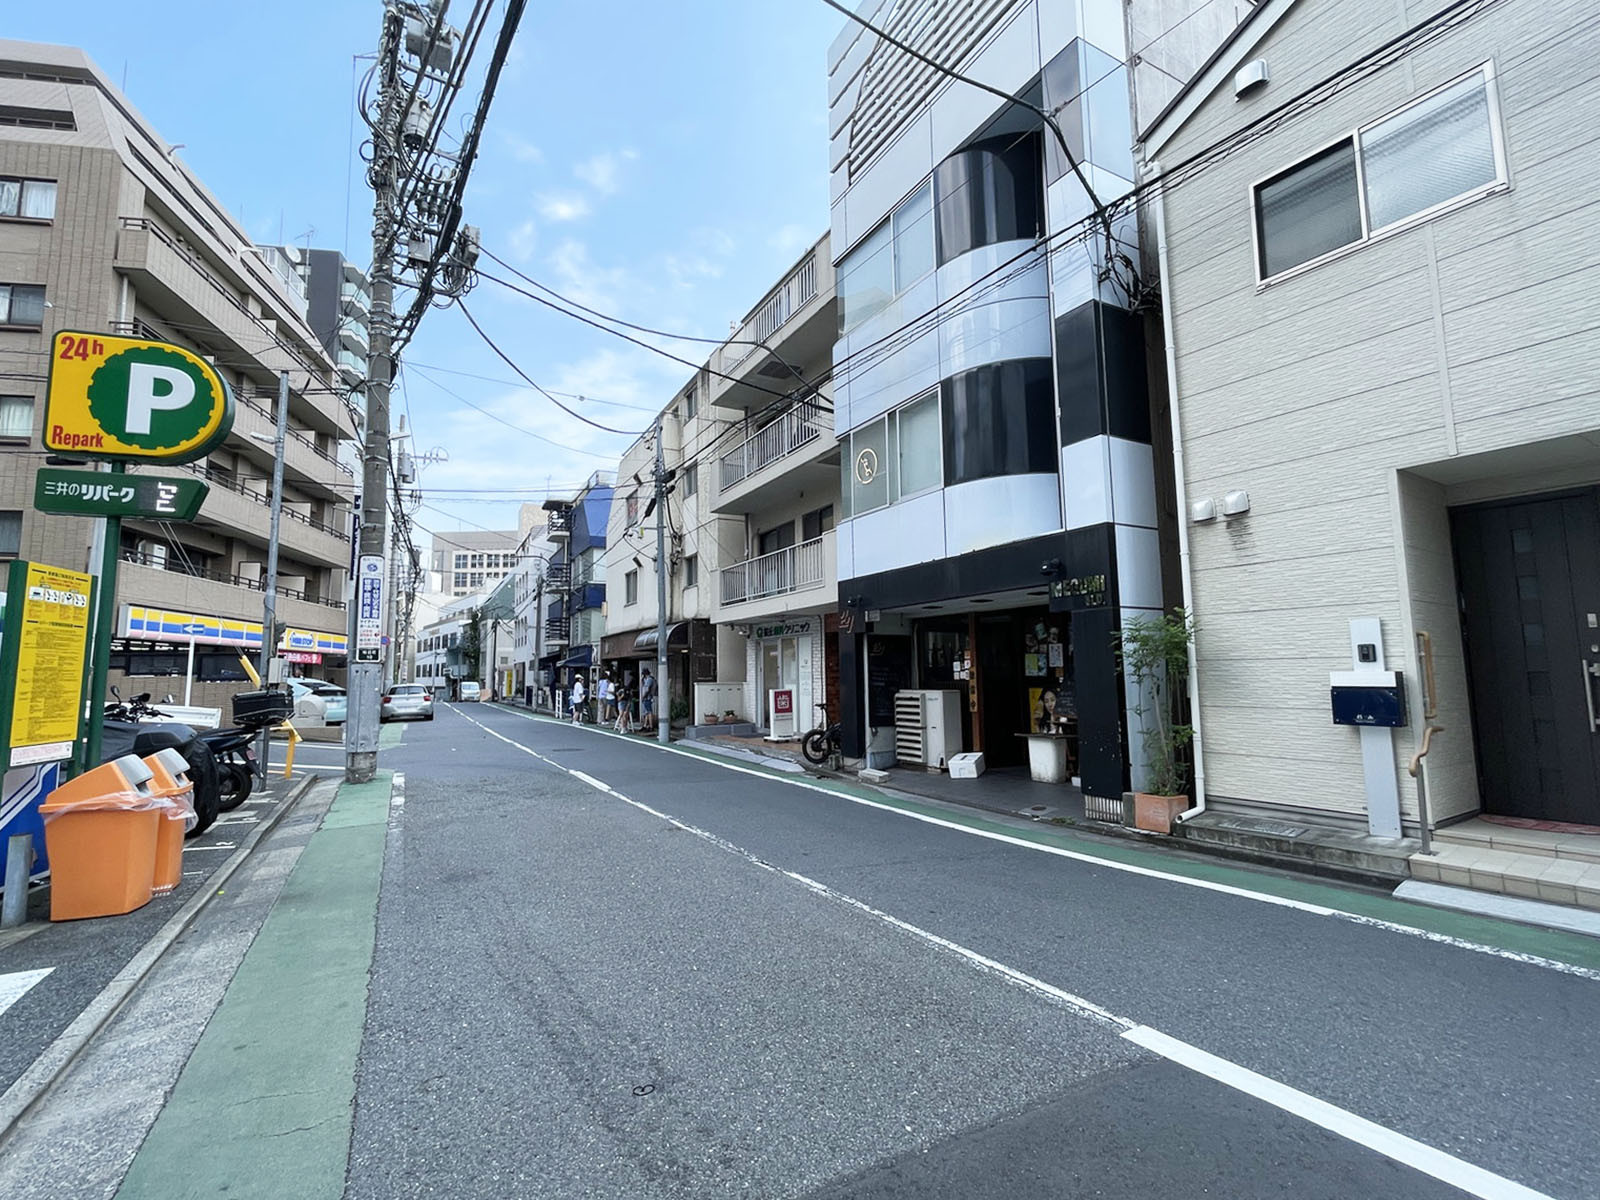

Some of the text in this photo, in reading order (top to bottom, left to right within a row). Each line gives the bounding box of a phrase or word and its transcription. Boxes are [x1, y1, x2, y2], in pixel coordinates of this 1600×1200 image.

[60, 335, 103, 361] 24h
[125, 362, 196, 435] P
[52, 425, 103, 449] Repark
[44, 481, 135, 503] 三井のリパーク
